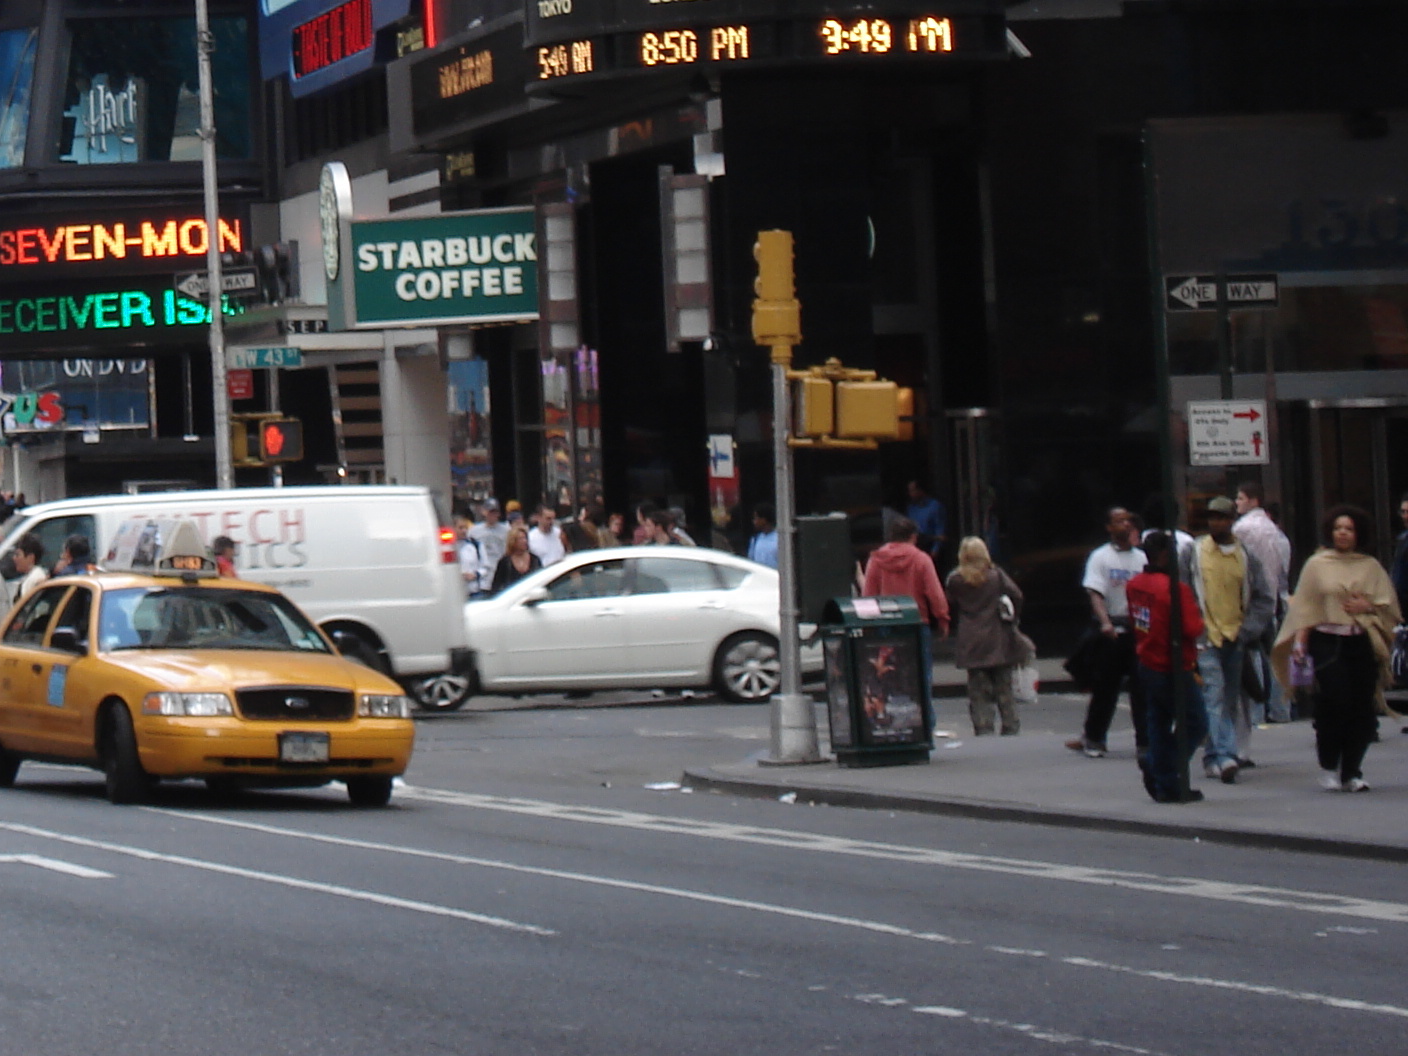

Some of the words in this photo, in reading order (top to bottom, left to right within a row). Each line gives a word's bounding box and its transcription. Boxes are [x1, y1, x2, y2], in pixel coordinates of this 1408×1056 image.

[641, 30, 699, 66] 8:50
[710, 26, 750, 60] PM
[358, 233, 537, 272] STARBUCK
[224, 274, 250, 290] WAY
[395, 266, 524, 302] COFFEE
[1180, 286, 1211, 302] ONE
[1230, 283, 1262, 299] WAY
[286, 320, 325, 334] SEP
[264, 348, 284, 366] 43
[64, 359, 93, 377] ON
[99, 359, 146, 376] DVD
[13, 392, 64, 425] US
